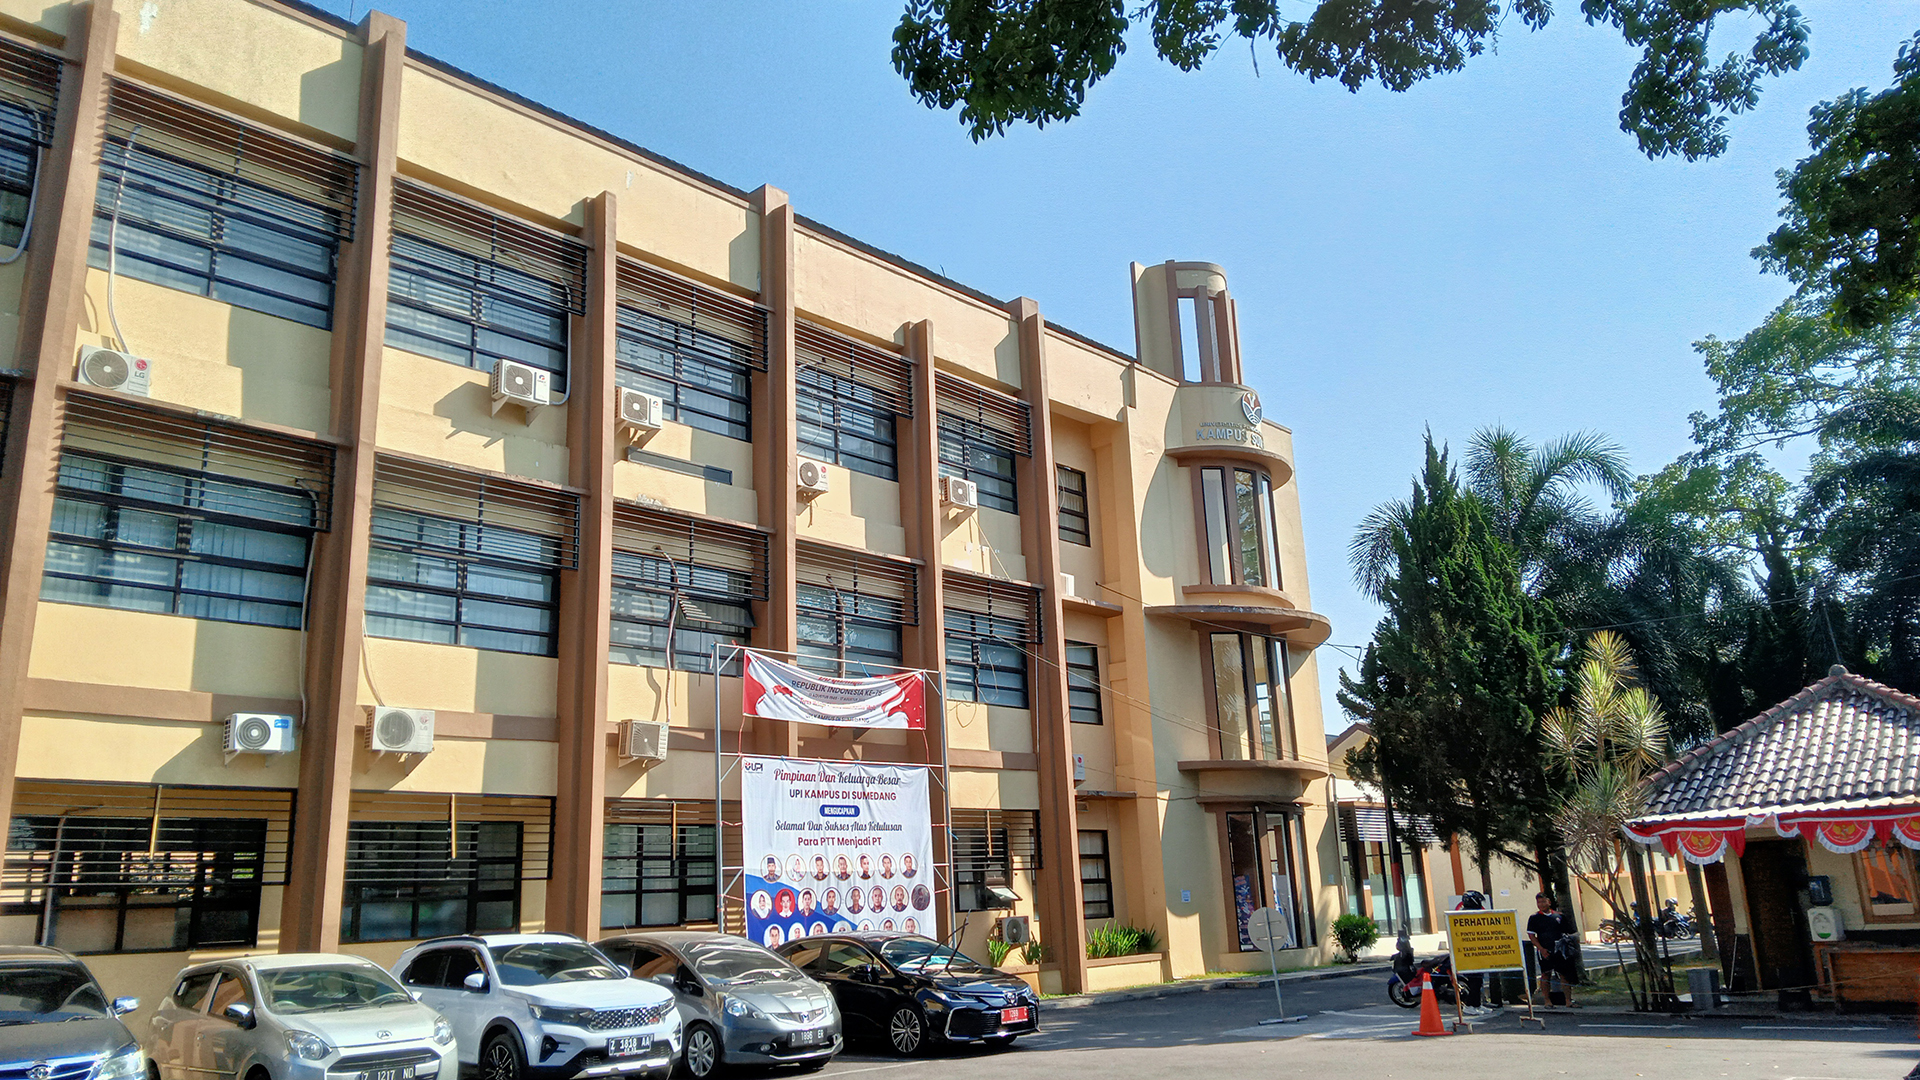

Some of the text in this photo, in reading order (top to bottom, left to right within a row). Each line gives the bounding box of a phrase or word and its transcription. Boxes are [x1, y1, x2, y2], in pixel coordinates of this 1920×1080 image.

[134, 371, 145, 379] LG
[1196, 428, 1248, 442] KAMPUS
[791, 680, 827, 693] REPUBLIK
[827, 686, 864, 696] INDONESIA
[751, 763, 764, 772] UPI
[774, 768, 901, 788] Pimpinan Dan Keluarga Besar
[789, 789, 897, 801] UPI KAMPUS DI SUMEDANG
[824, 807, 855, 815] MENGUCAPKAN
[775, 820, 903, 832] Selamat Dan Sukses Atas Kelulusan
[797, 836, 882, 849] Para PTT Menjadi PT
[1454, 917, 1501, 927] PERHATIAN
[610, 1040, 616, 1050] Z
[619, 1038, 637, 1049] 1818
[641, 1036, 650, 1047] AA
[791, 1032, 796, 1042] D
[377, 1069, 396, 1080] 1217
